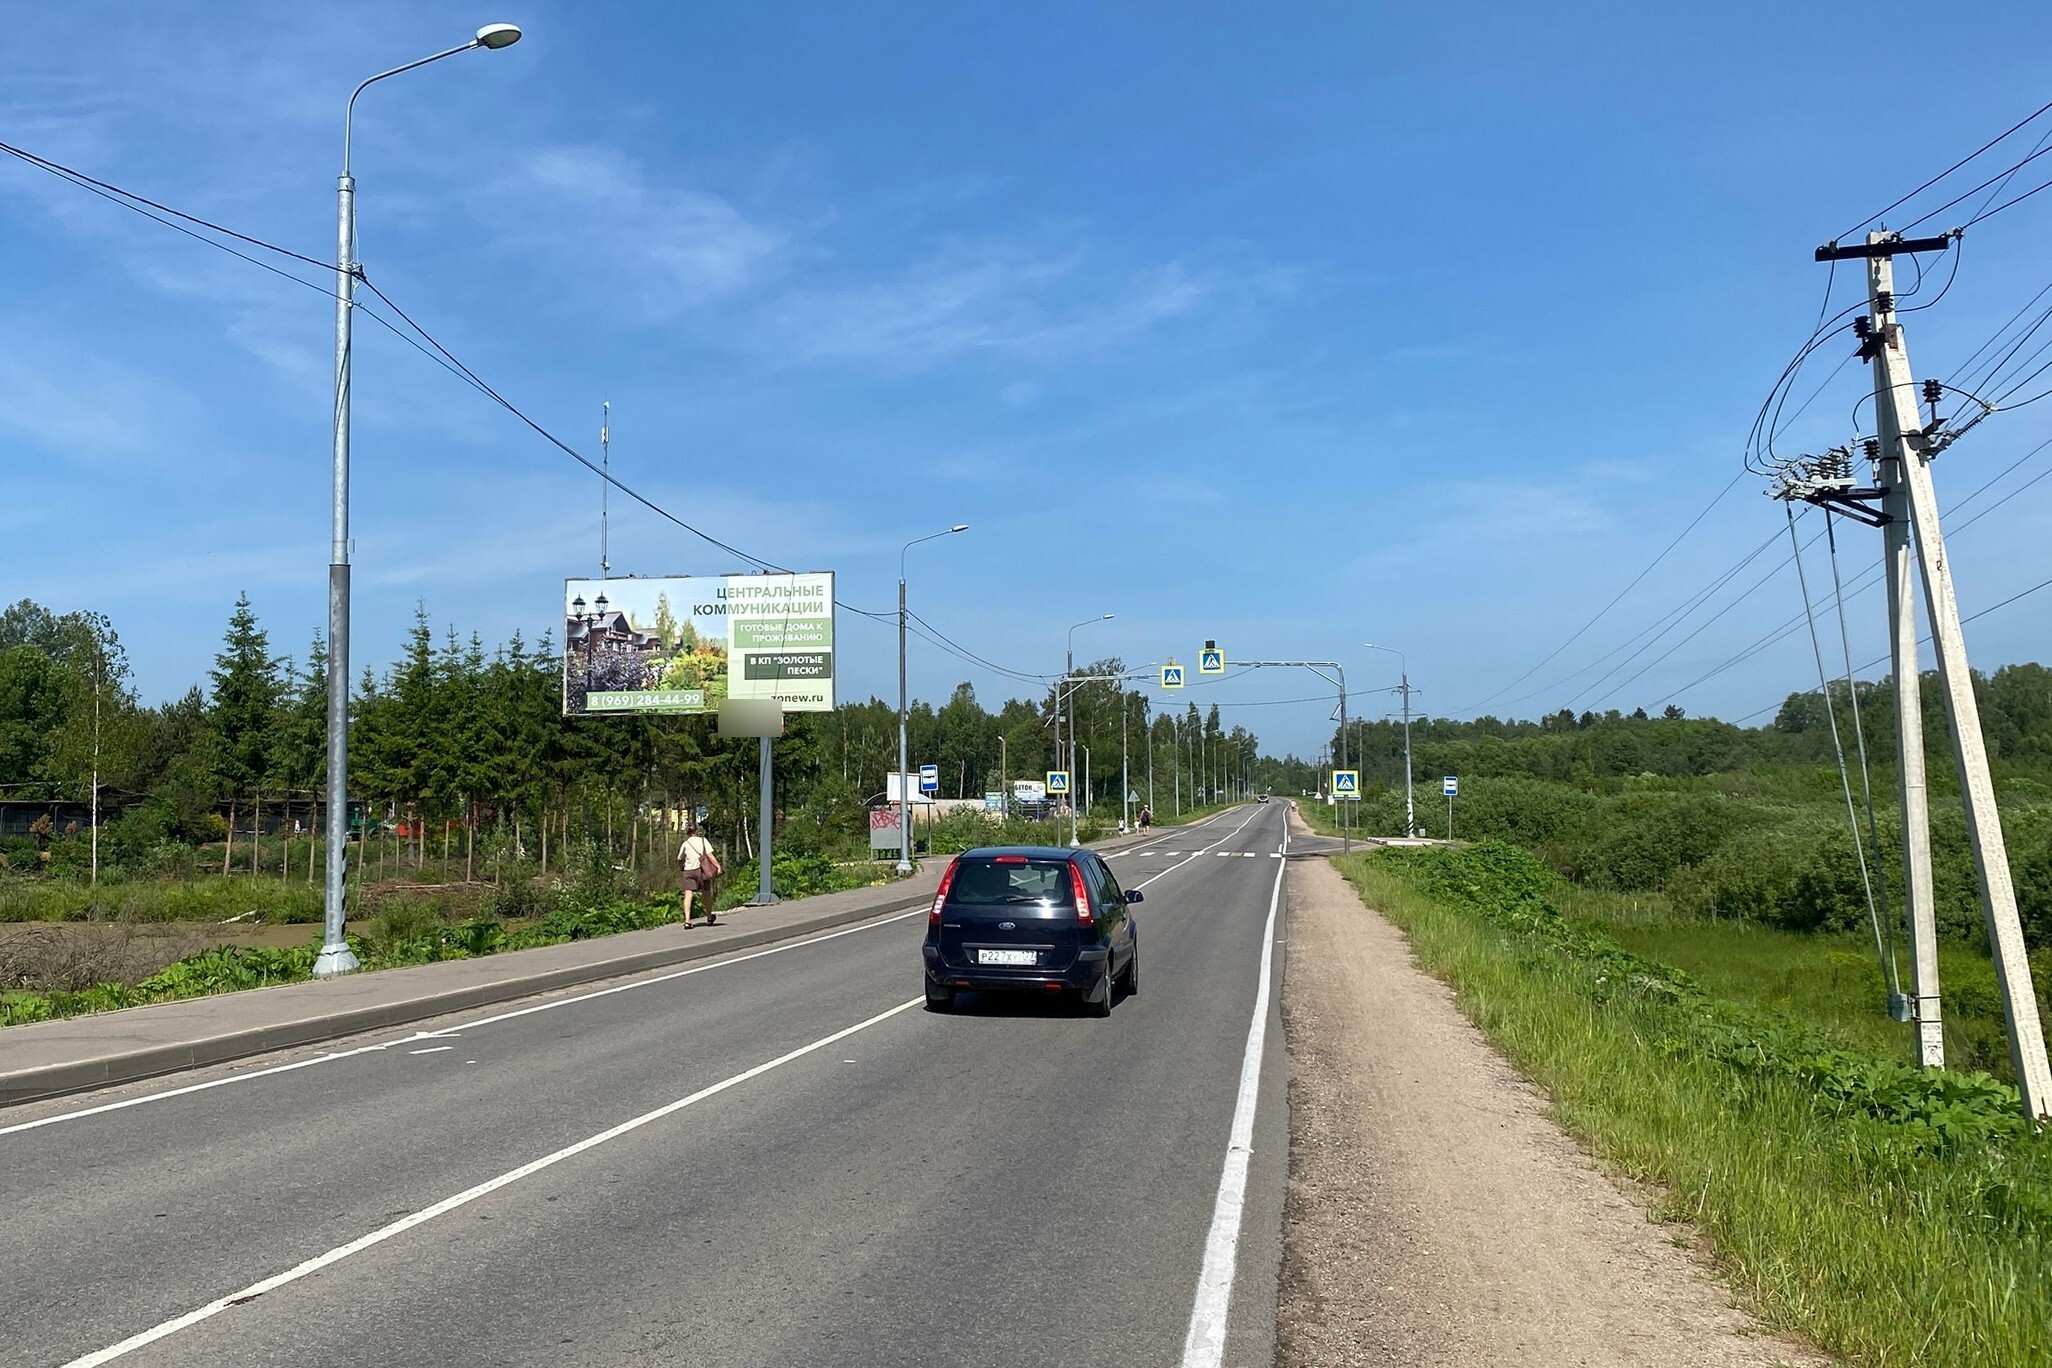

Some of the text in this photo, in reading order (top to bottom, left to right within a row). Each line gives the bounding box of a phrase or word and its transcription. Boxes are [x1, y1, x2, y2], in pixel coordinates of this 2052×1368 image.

[717, 585, 824, 600] ЦЕНТРАЛЬНЫЕ
[693, 601, 824, 616] КОММУНИКАЦИИ
[740, 622, 823, 632] ГОТОВЫЕ ДОМА К
[752, 634, 823, 643] ПРОЖИВАНИЮ
[750, 655, 824, 665] В КП "ЗОЛОТЫЕ
[787, 666, 823, 675] ПЕСКИ"
[591, 693, 700, 707] 8 (969) 284-44-99
